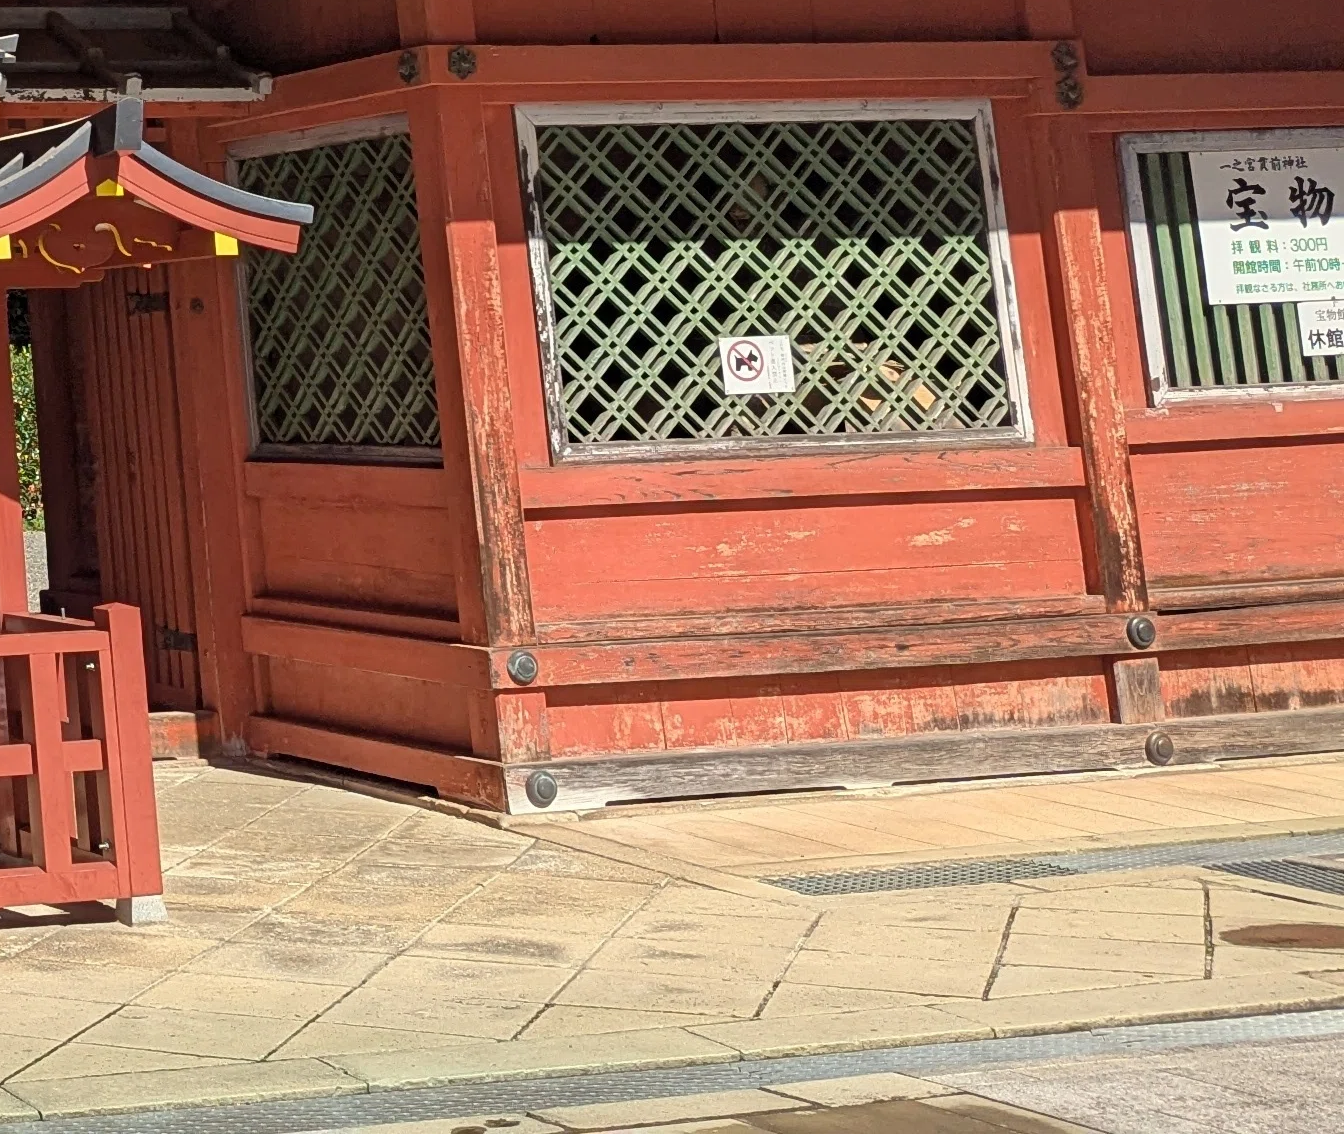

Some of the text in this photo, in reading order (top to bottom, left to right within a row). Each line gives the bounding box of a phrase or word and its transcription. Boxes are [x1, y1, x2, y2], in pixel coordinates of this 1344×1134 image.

[1219, 156, 1308, 172] 一之宮貫前神社
[1225, 175, 1335, 232] 宝物
[1232, 257, 1344, 275] 開館時間：午前10時
[1236, 281, 1344, 294] 拝観なさる方は、社務所へお
[1307, 328, 1344, 350] 休館
